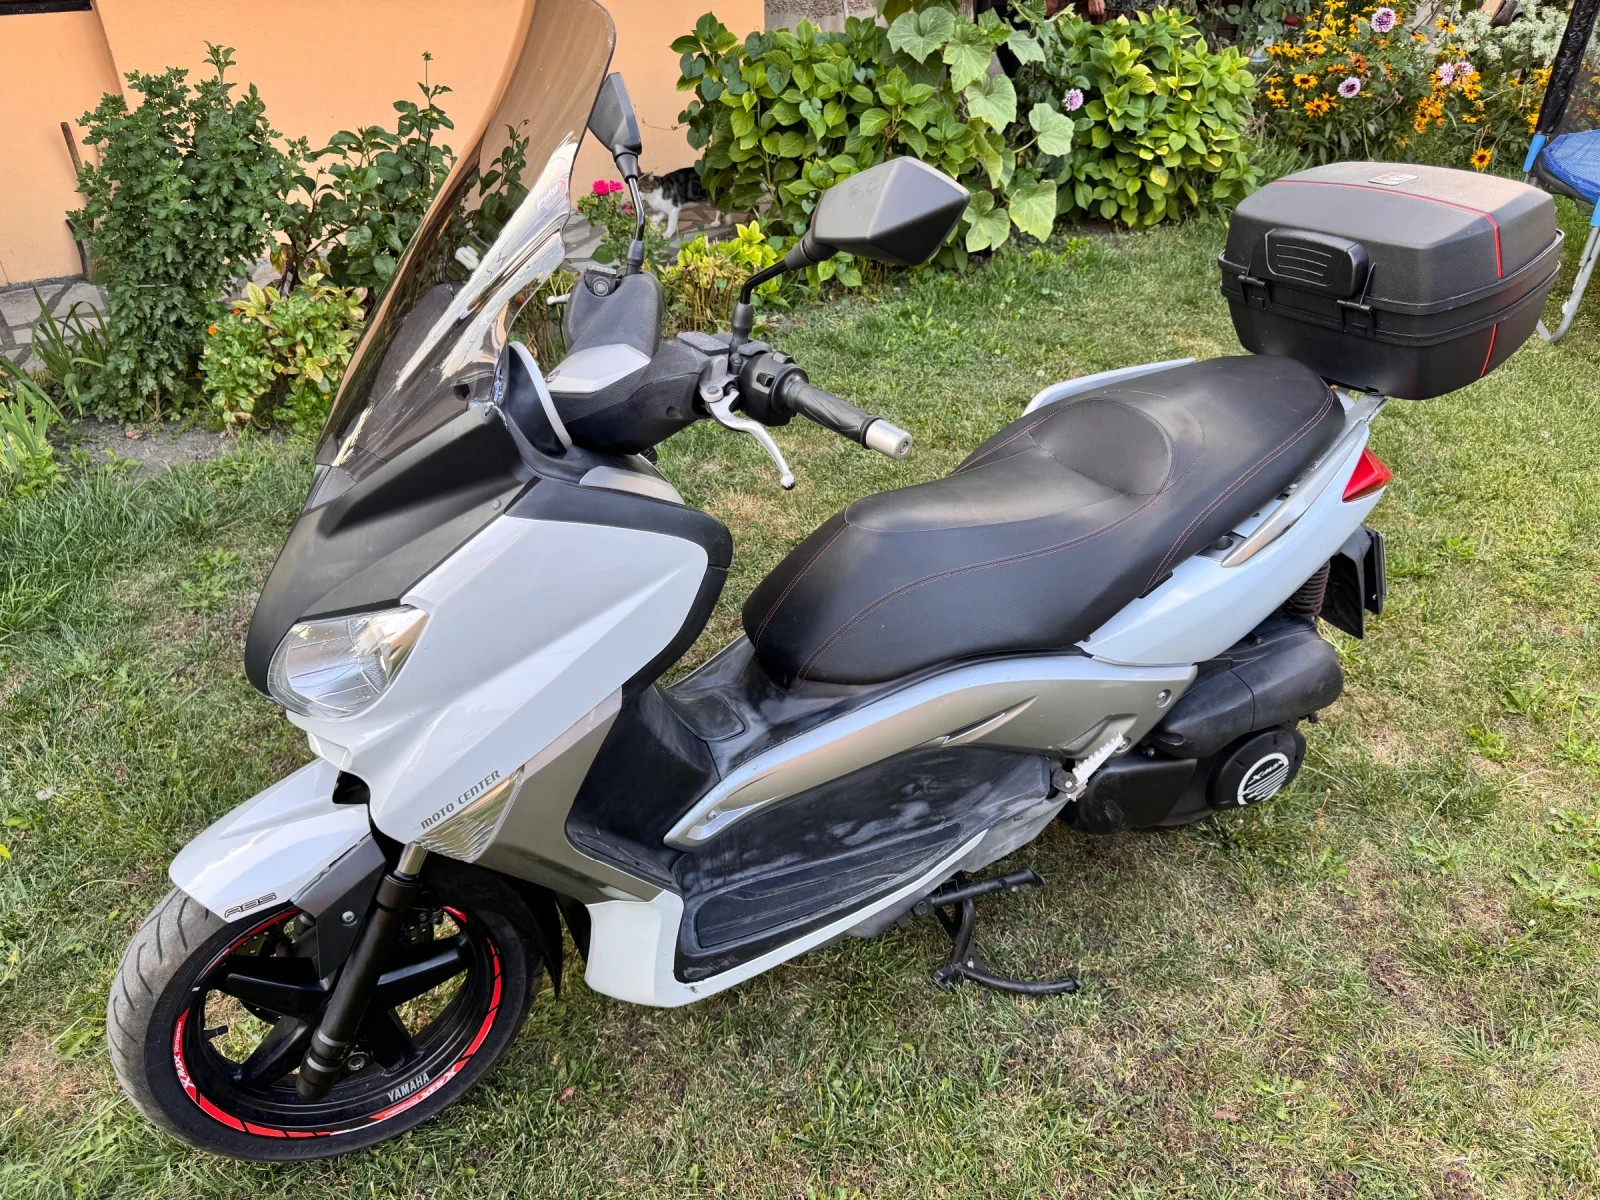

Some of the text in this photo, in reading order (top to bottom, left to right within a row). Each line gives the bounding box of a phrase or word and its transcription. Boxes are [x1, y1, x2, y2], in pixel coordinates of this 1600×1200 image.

[420, 770, 501, 829] MOTO CENTER
[224, 892, 277, 918] ABS
[387, 1072, 430, 1102] YAMAHA
